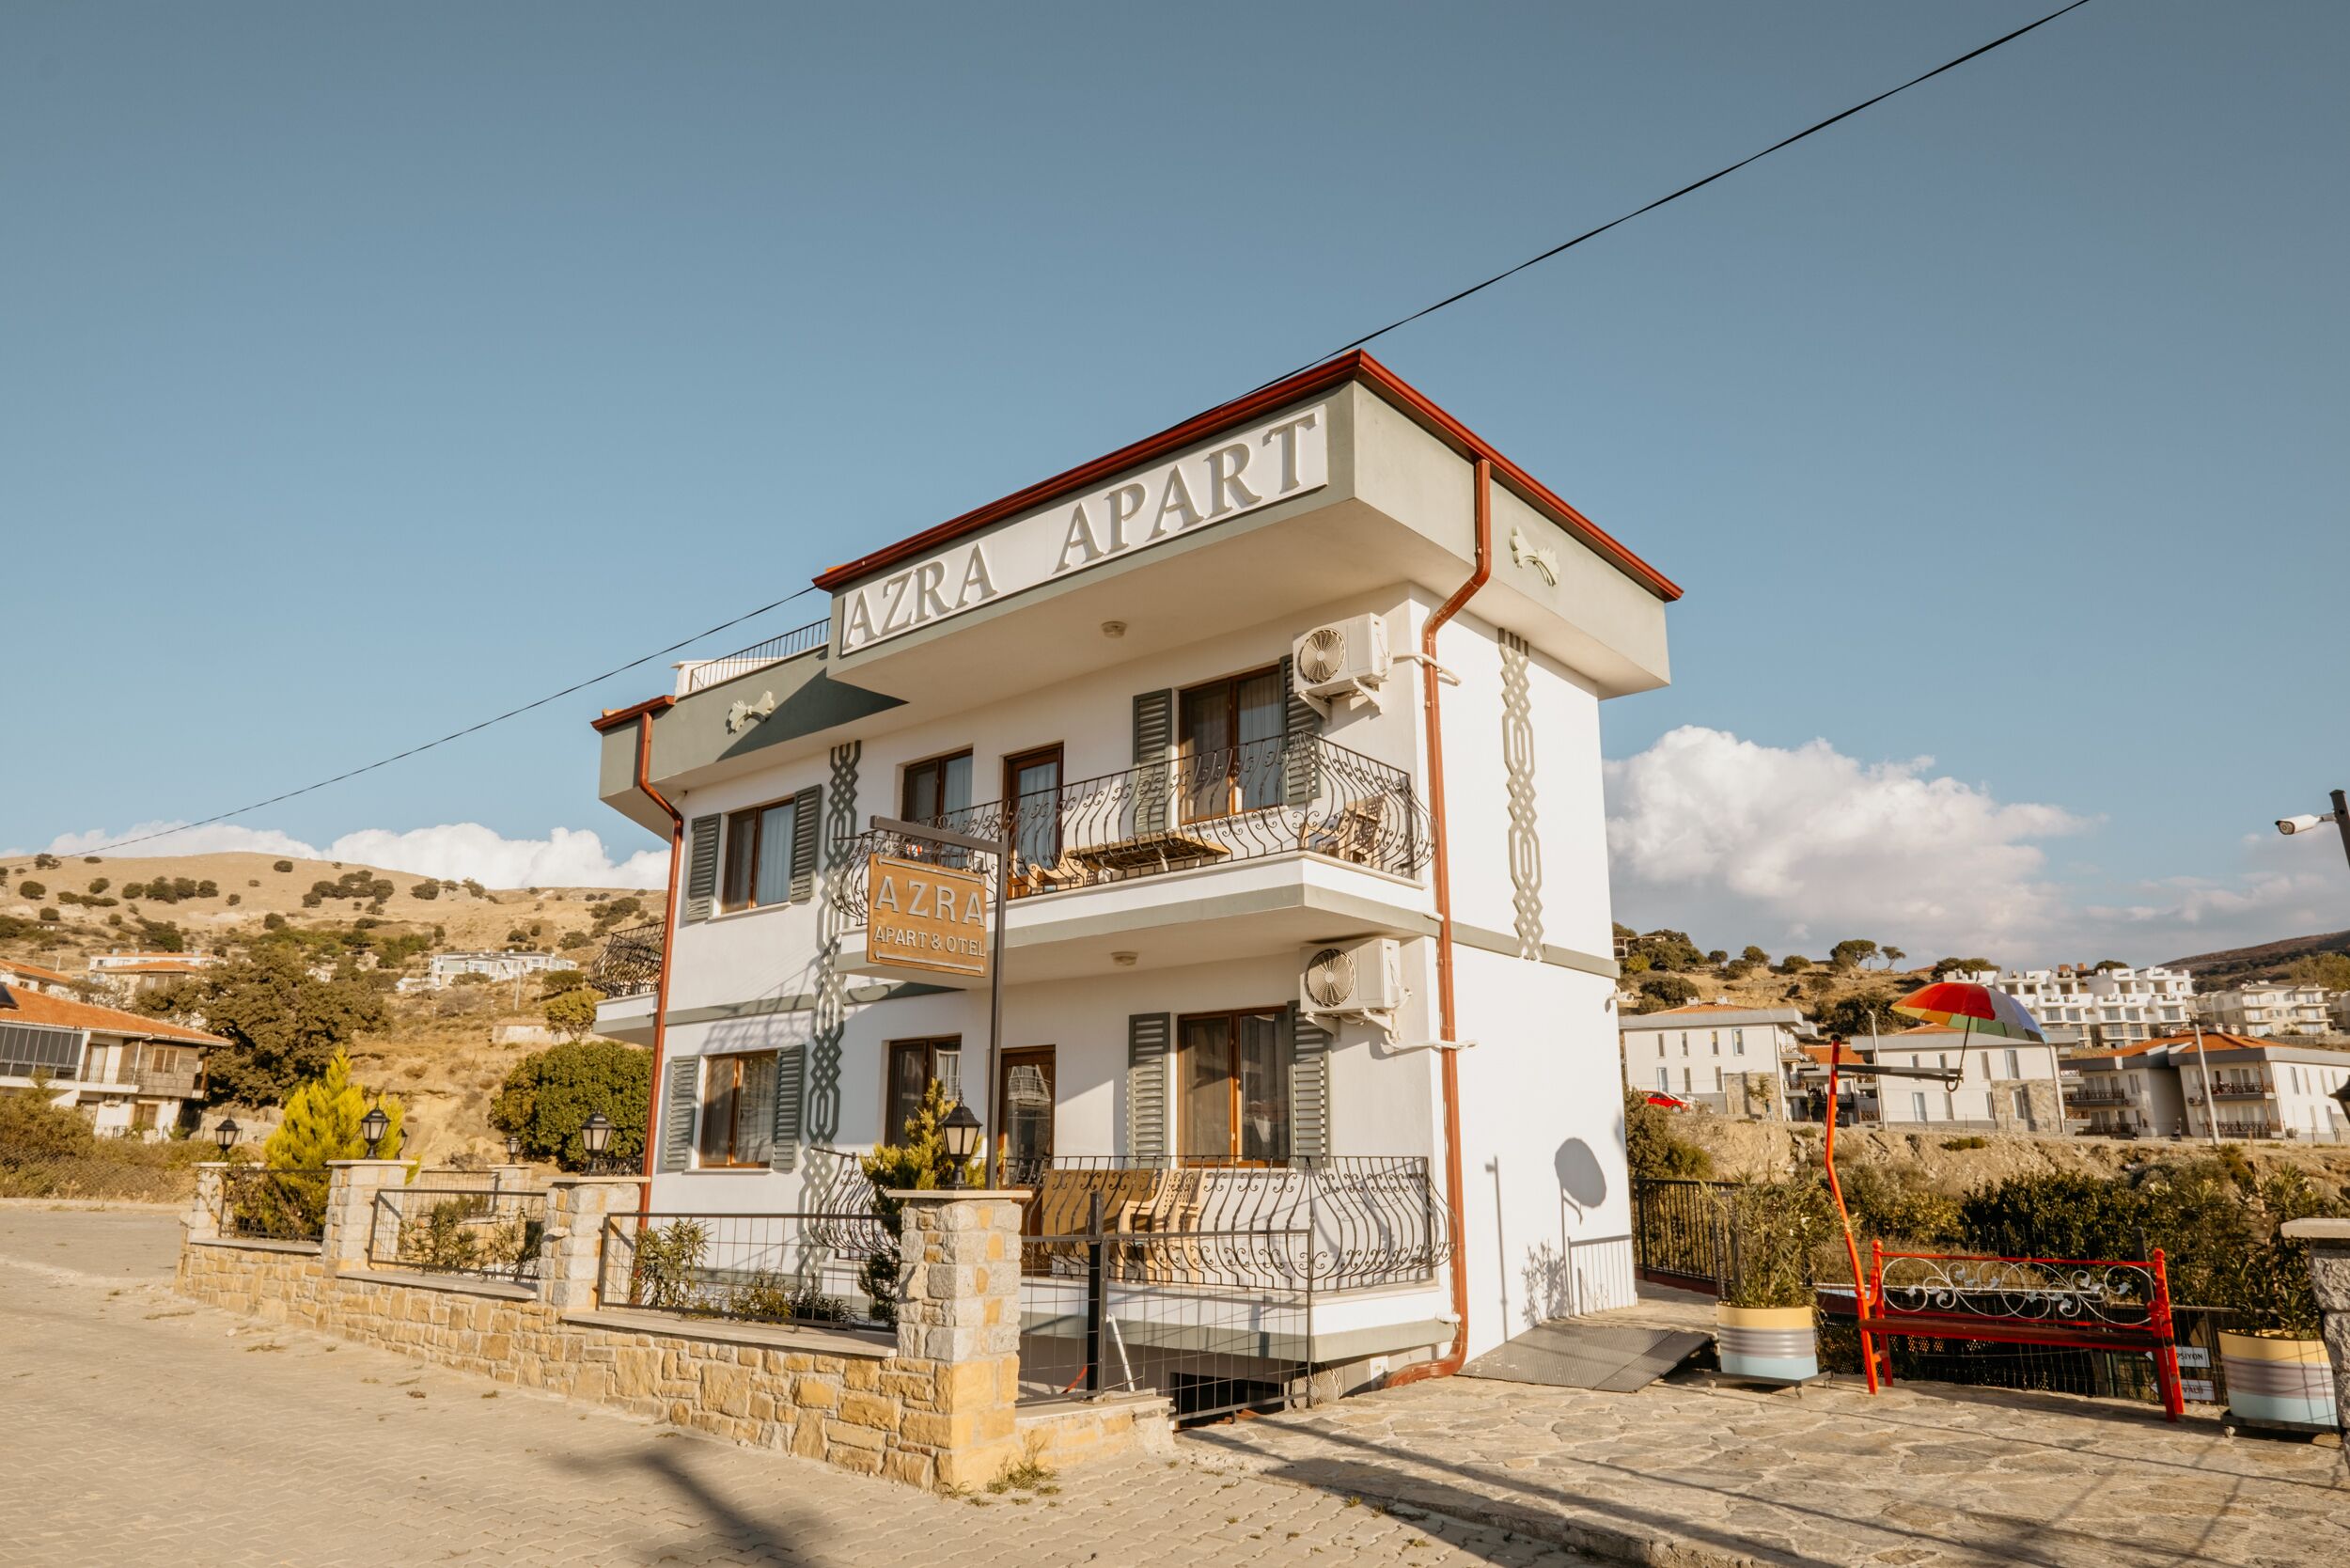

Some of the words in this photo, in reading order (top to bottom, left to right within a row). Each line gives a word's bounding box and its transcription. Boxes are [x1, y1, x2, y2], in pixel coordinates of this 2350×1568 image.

[842, 542, 999, 650] AZRA
[1052, 413, 1316, 575] APART
[874, 875, 985, 927] AZRA
[874, 926, 927, 949] APART
[931, 933, 941, 950] &
[946, 935, 985, 957] OTEL
